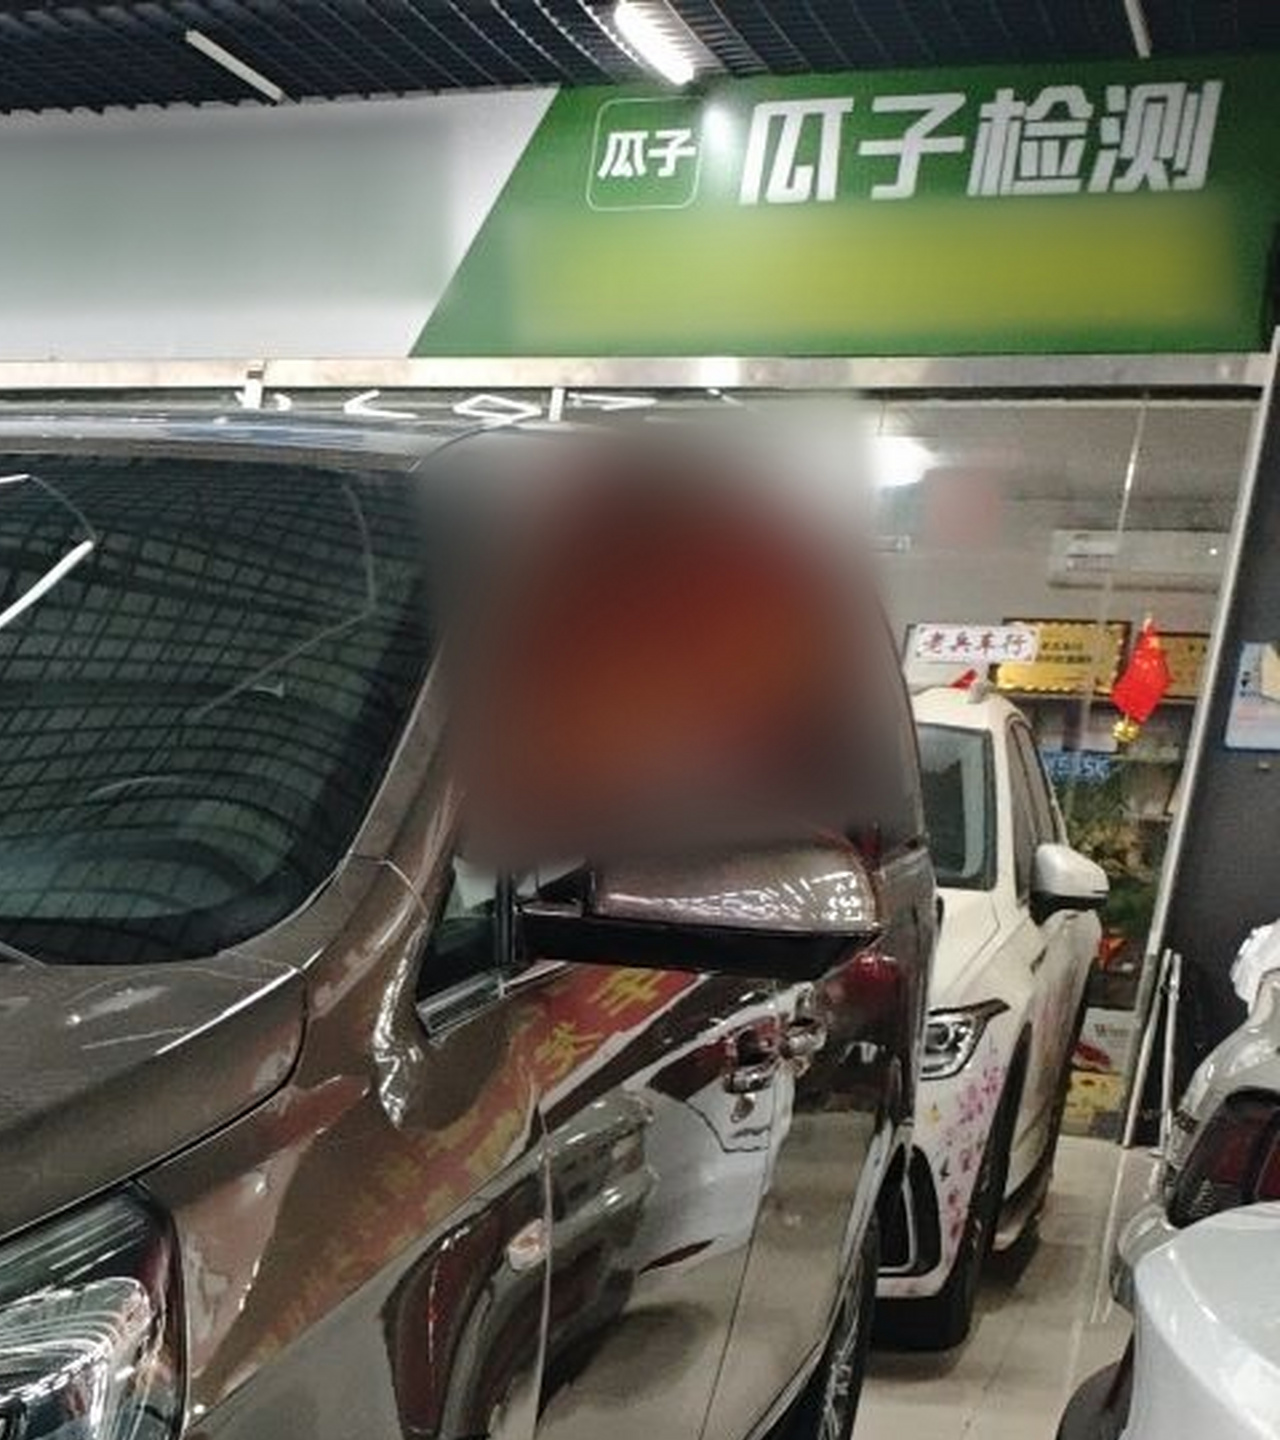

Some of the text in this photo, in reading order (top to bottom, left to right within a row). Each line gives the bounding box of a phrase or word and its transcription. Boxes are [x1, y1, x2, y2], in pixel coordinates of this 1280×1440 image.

[598, 79, 1224, 206] 瓜子 瓜子检测
